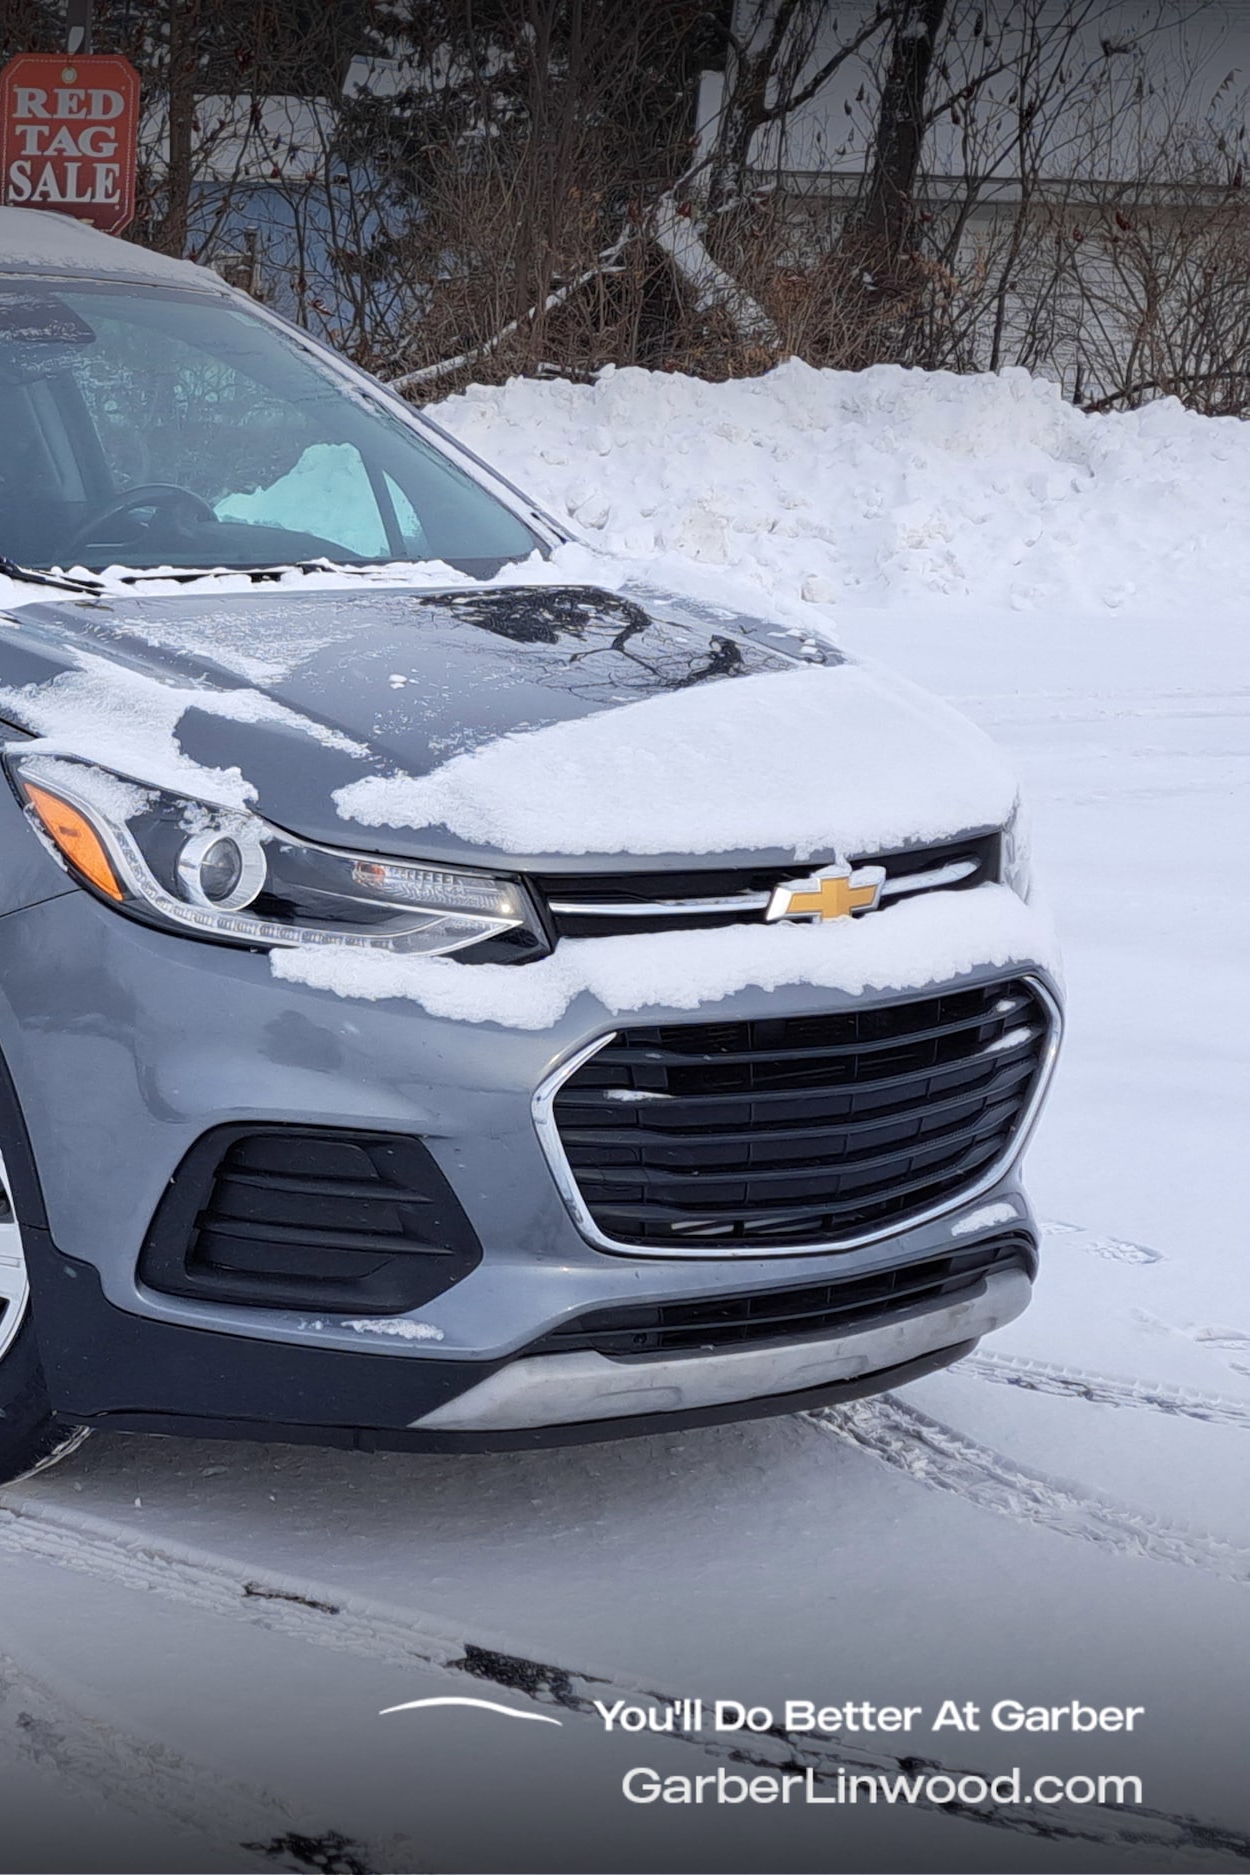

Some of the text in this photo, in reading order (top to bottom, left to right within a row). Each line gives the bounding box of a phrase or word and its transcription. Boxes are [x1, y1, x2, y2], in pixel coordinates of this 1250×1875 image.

[12, 87, 125, 120] RED
[15, 124, 119, 158] TAG
[8, 159, 121, 203] SALE
